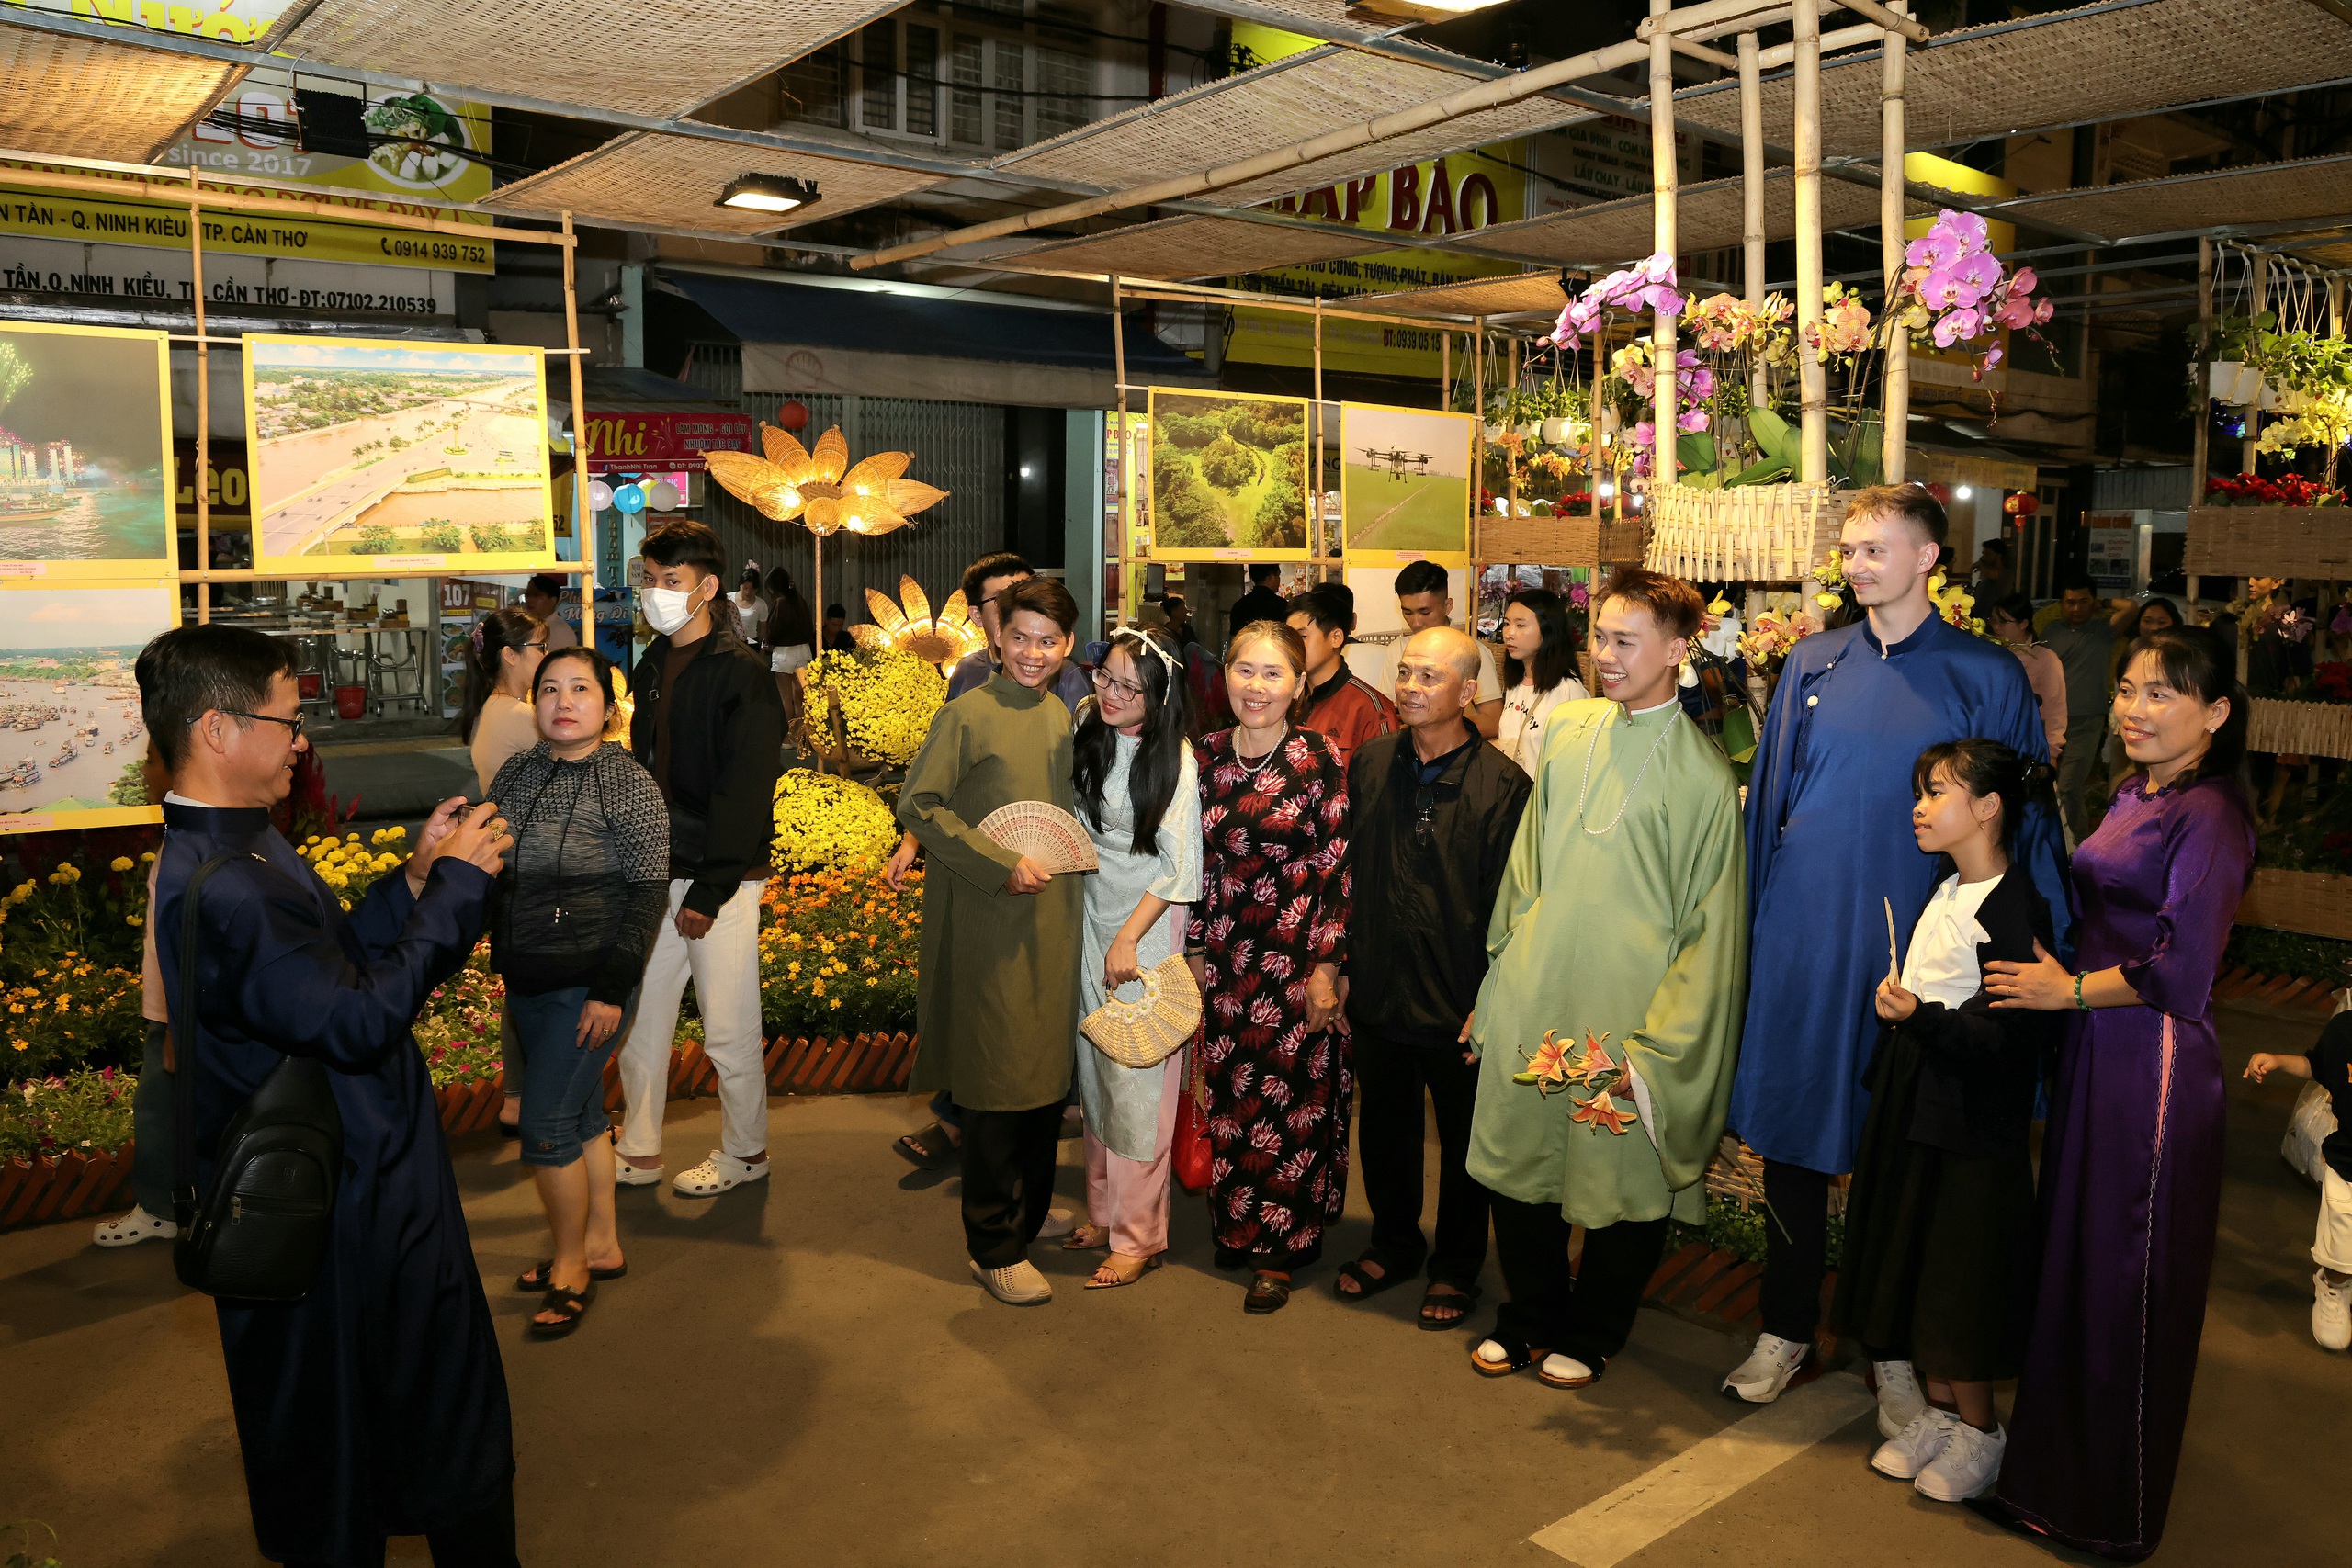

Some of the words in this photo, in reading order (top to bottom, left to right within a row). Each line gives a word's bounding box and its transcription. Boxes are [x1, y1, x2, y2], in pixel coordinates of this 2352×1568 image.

[169, 143, 239, 169] since
[247, 152, 311, 176] 2017
[72, 210, 90, 230] Q.
[96, 213, 139, 233] NINH
[202, 223, 227, 243] TP.
[272, 230, 308, 248] THƠ
[394, 241, 428, 259] 0914
[433, 244, 457, 261] 939
[461, 246, 485, 264] 752
[213, 276, 248, 303] CẦN
[1396, 329, 1417, 349] 0939
[1419, 331, 1429, 350] 05
[584, 418, 648, 456] Nhi
[444, 584, 470, 606] 107
